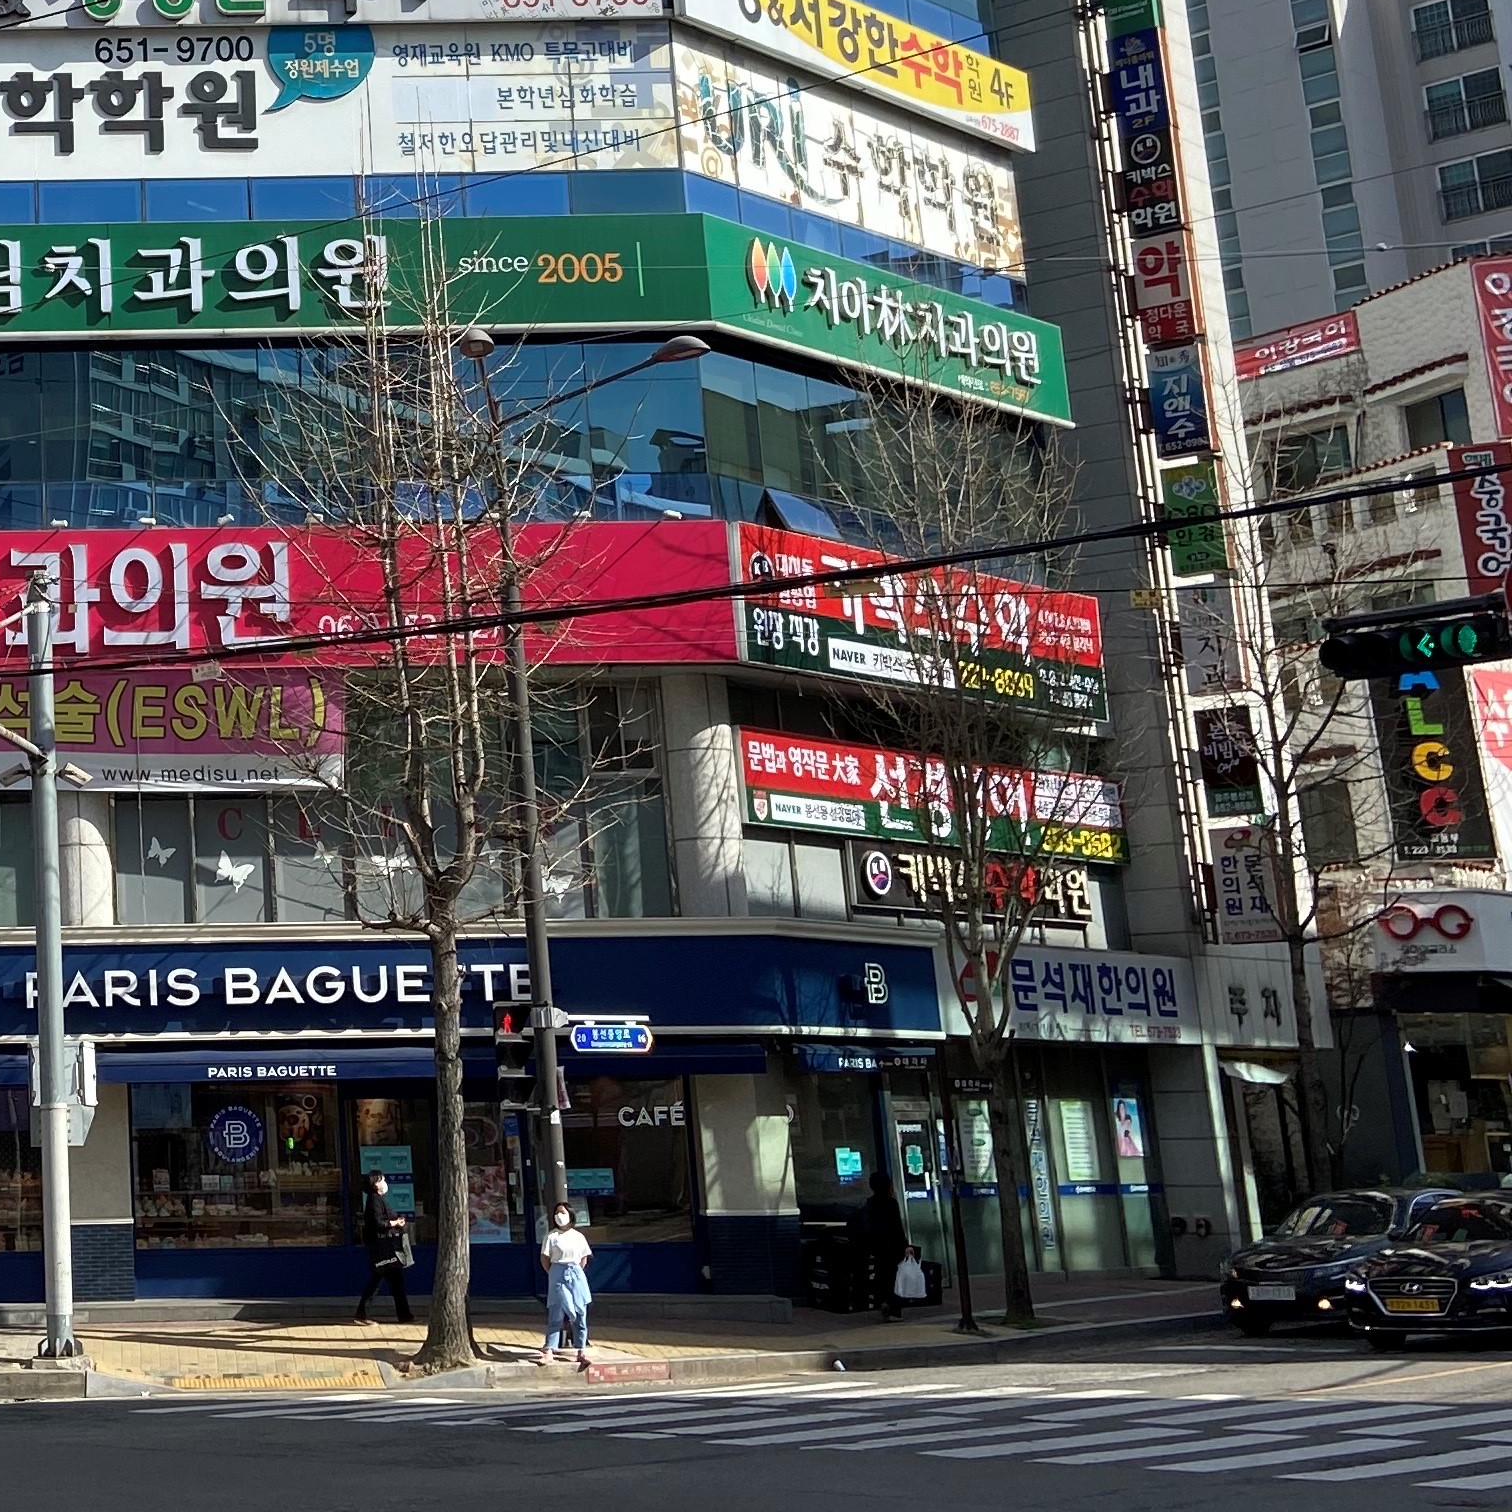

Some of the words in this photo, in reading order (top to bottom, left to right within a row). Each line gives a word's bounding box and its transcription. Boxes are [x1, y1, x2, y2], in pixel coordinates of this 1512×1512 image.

[95, 35, 254, 63] 651-9700
[304, 30, 337, 55] 5명
[392, 42, 482, 67] 영재교육원
[491, 42, 535, 63] KMO
[544, 39, 635, 64] 특목고대비
[284, 58, 360, 80] 정원제수업
[496, 84, 638, 109] 본학년심화학습
[990, 68, 1015, 110] 4F
[1120, 63, 1161, 116] 내과
[1131, 115, 1156, 129] 2F
[1126, 163, 1172, 184] 키박스
[1132, 201, 1177, 227] 학원
[458, 249, 530, 275] since
[536, 252, 623, 284] 2005
[1138, 240, 1183, 298] 약
[1146, 301, 1187, 323] 정다운
[832, 648, 866, 665] NAVER
[747, 741, 787, 774] 문법과
[788, 746, 831, 781] 영작문
[101, 764, 280, 785] www.medisu.net
[775, 802, 802, 816] NAVER
[226, 965, 533, 1005] BAGUETE
[1010, 958, 1179, 1019] 문석재한의원
[207, 1065, 253, 1078] PARIS
[256, 1064, 337, 1078] BAGUETTE
[618, 1100, 685, 1126] CAFÉ
